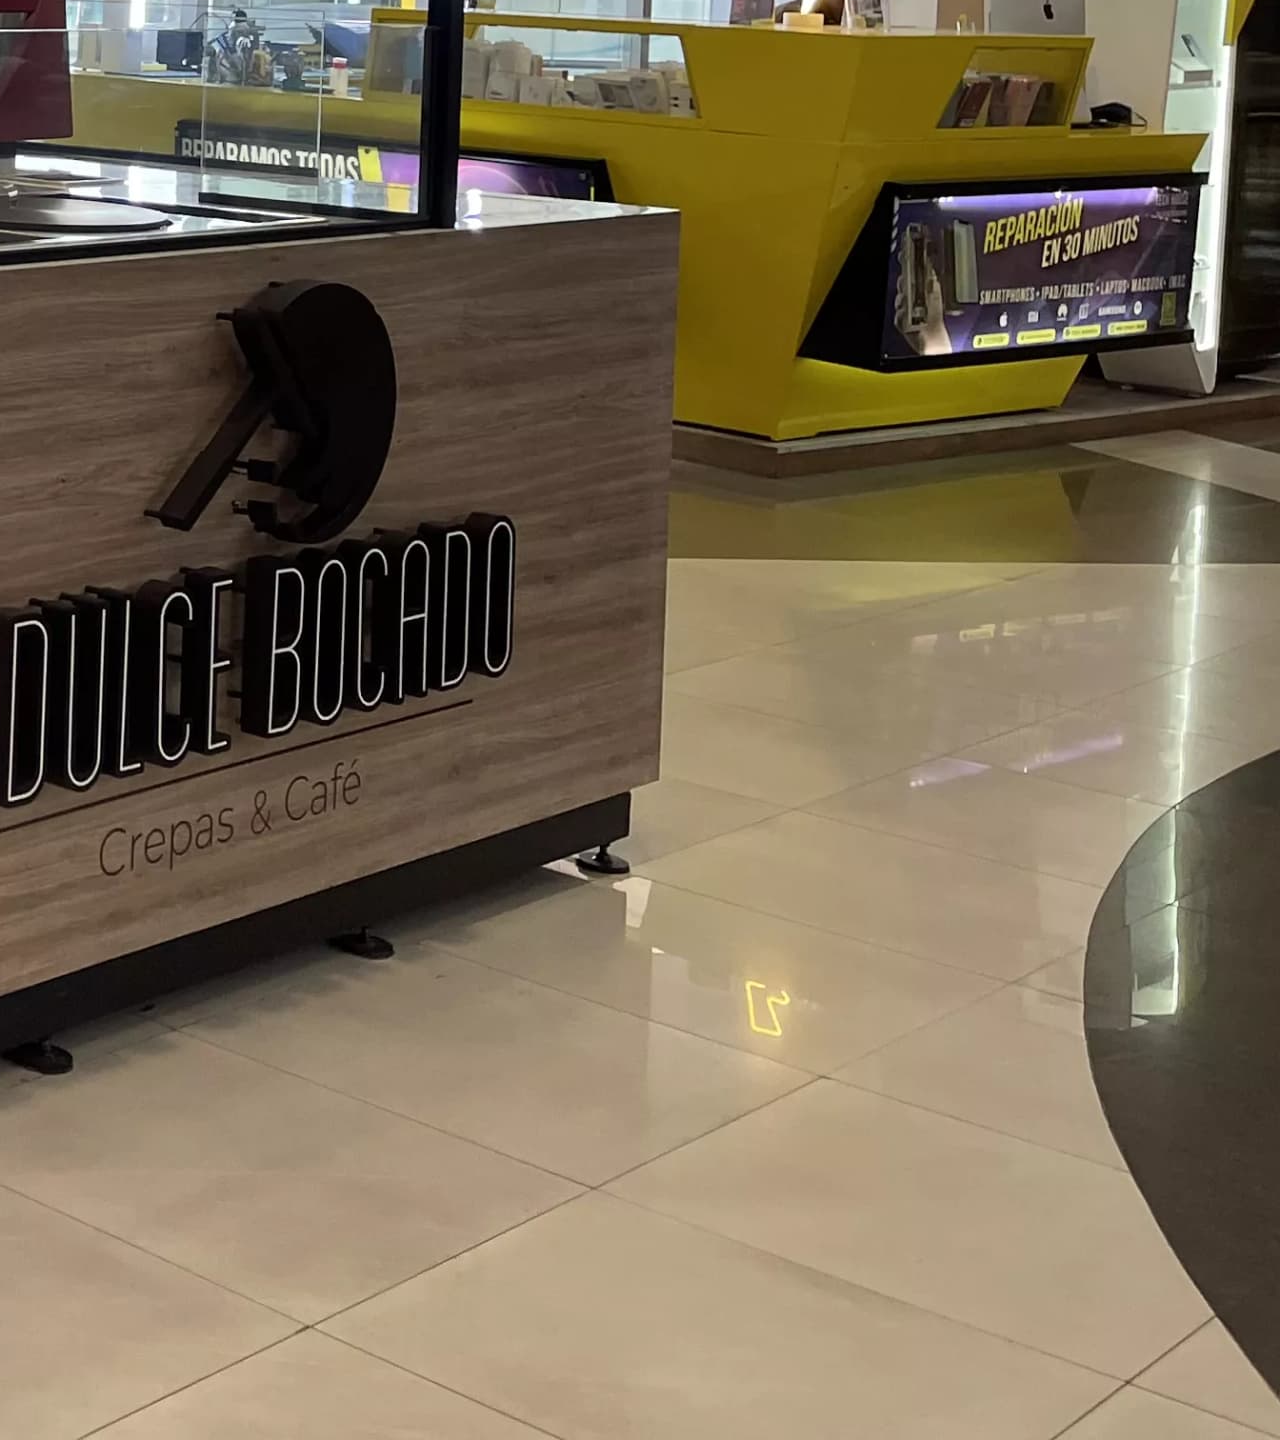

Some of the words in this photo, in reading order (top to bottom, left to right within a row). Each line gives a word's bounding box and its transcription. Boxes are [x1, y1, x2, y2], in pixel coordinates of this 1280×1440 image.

[983, 195, 1085, 255] REPARACIÓN
[1041, 237, 1062, 268] EN
[1062, 232, 1081, 262] 30
[1082, 215, 1140, 257] MINUTOS
[980, 286, 1035, 305] SMARTPHONES
[0, 574, 233, 804] DULCE
[262, 518, 514, 735] BOCADO
[99, 805, 235, 877] Crepas
[249, 789, 274, 836] &
[284, 759, 362, 822] Café
